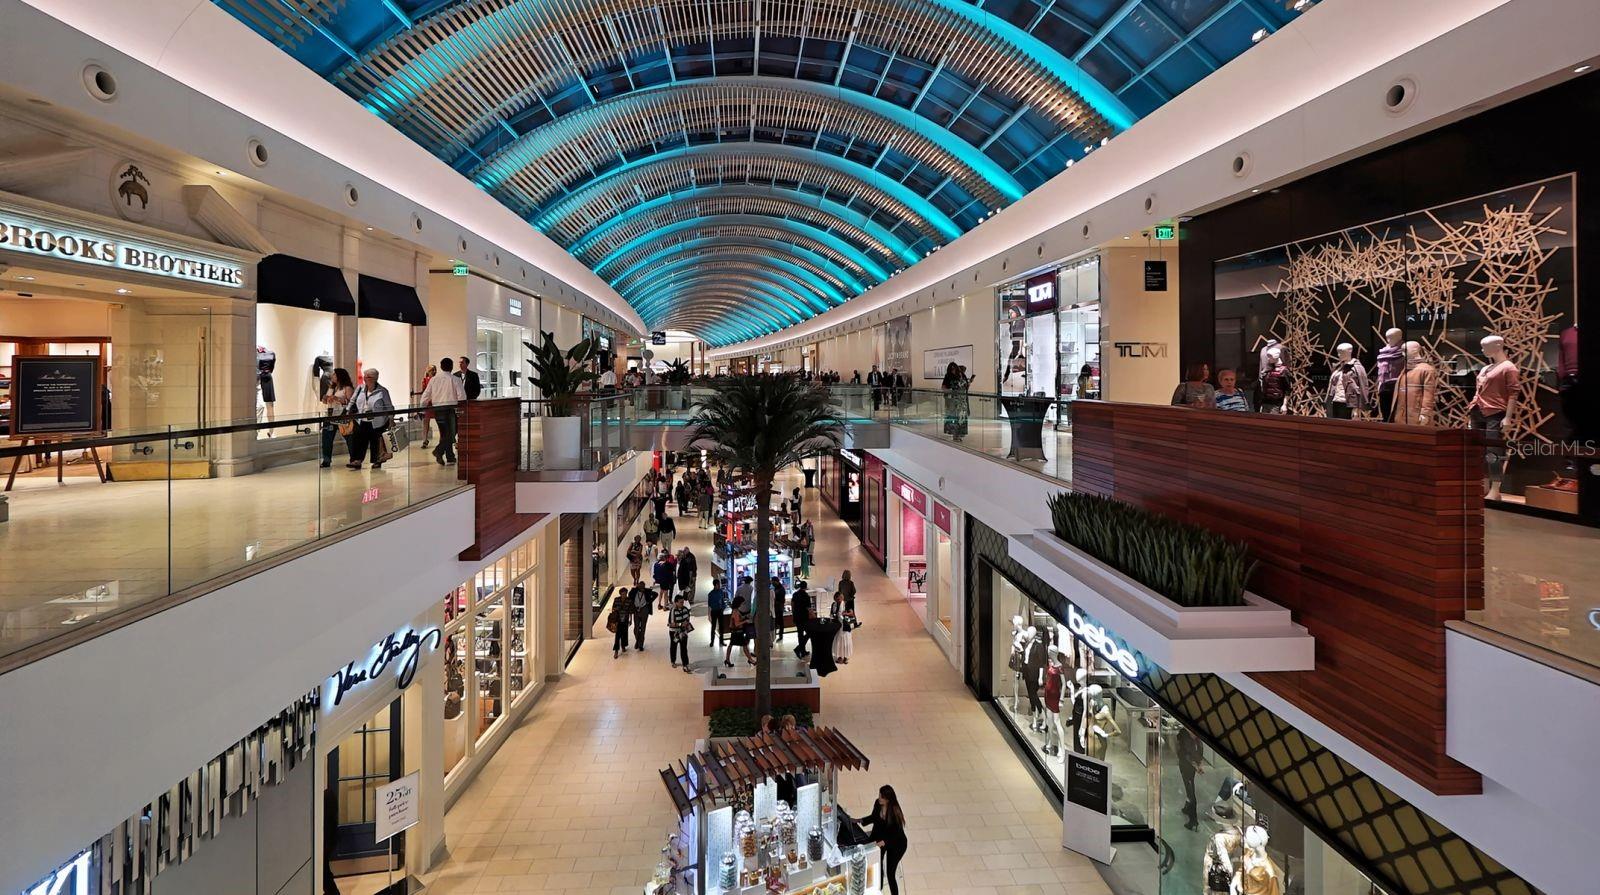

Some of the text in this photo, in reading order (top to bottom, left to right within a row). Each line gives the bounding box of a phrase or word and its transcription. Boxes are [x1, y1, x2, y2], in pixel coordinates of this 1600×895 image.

[124, 247, 245, 285] BROTHERS
[1028, 281, 1054, 303] TUMI
[1114, 342, 1168, 358] TUMI
[1068, 603, 1139, 678] bebe
[332, 628, 442, 706] Vera Bradley
[1075, 762, 1101, 775] bebe
